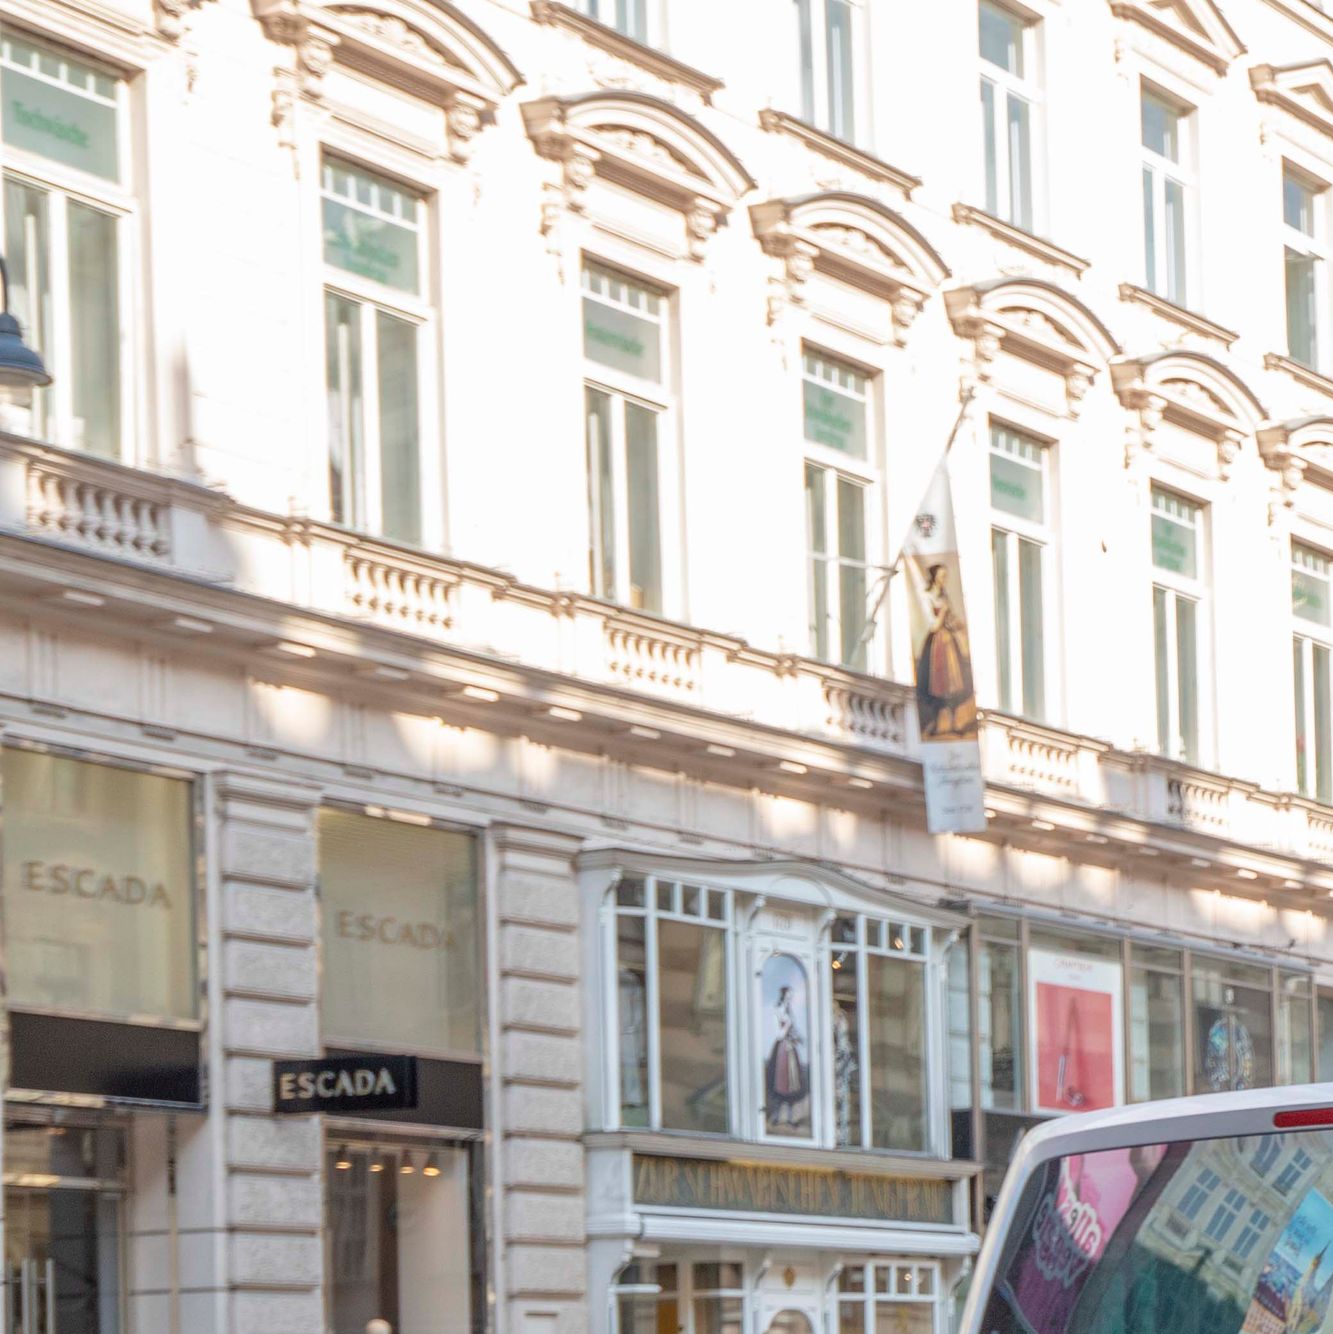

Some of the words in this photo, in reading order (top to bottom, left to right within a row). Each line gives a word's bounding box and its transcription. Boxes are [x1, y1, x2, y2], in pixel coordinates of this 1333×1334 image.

[22, 861, 173, 910] ESCADA
[336, 910, 458, 951] ESCADA
[279, 1067, 396, 1101] ESCADA
